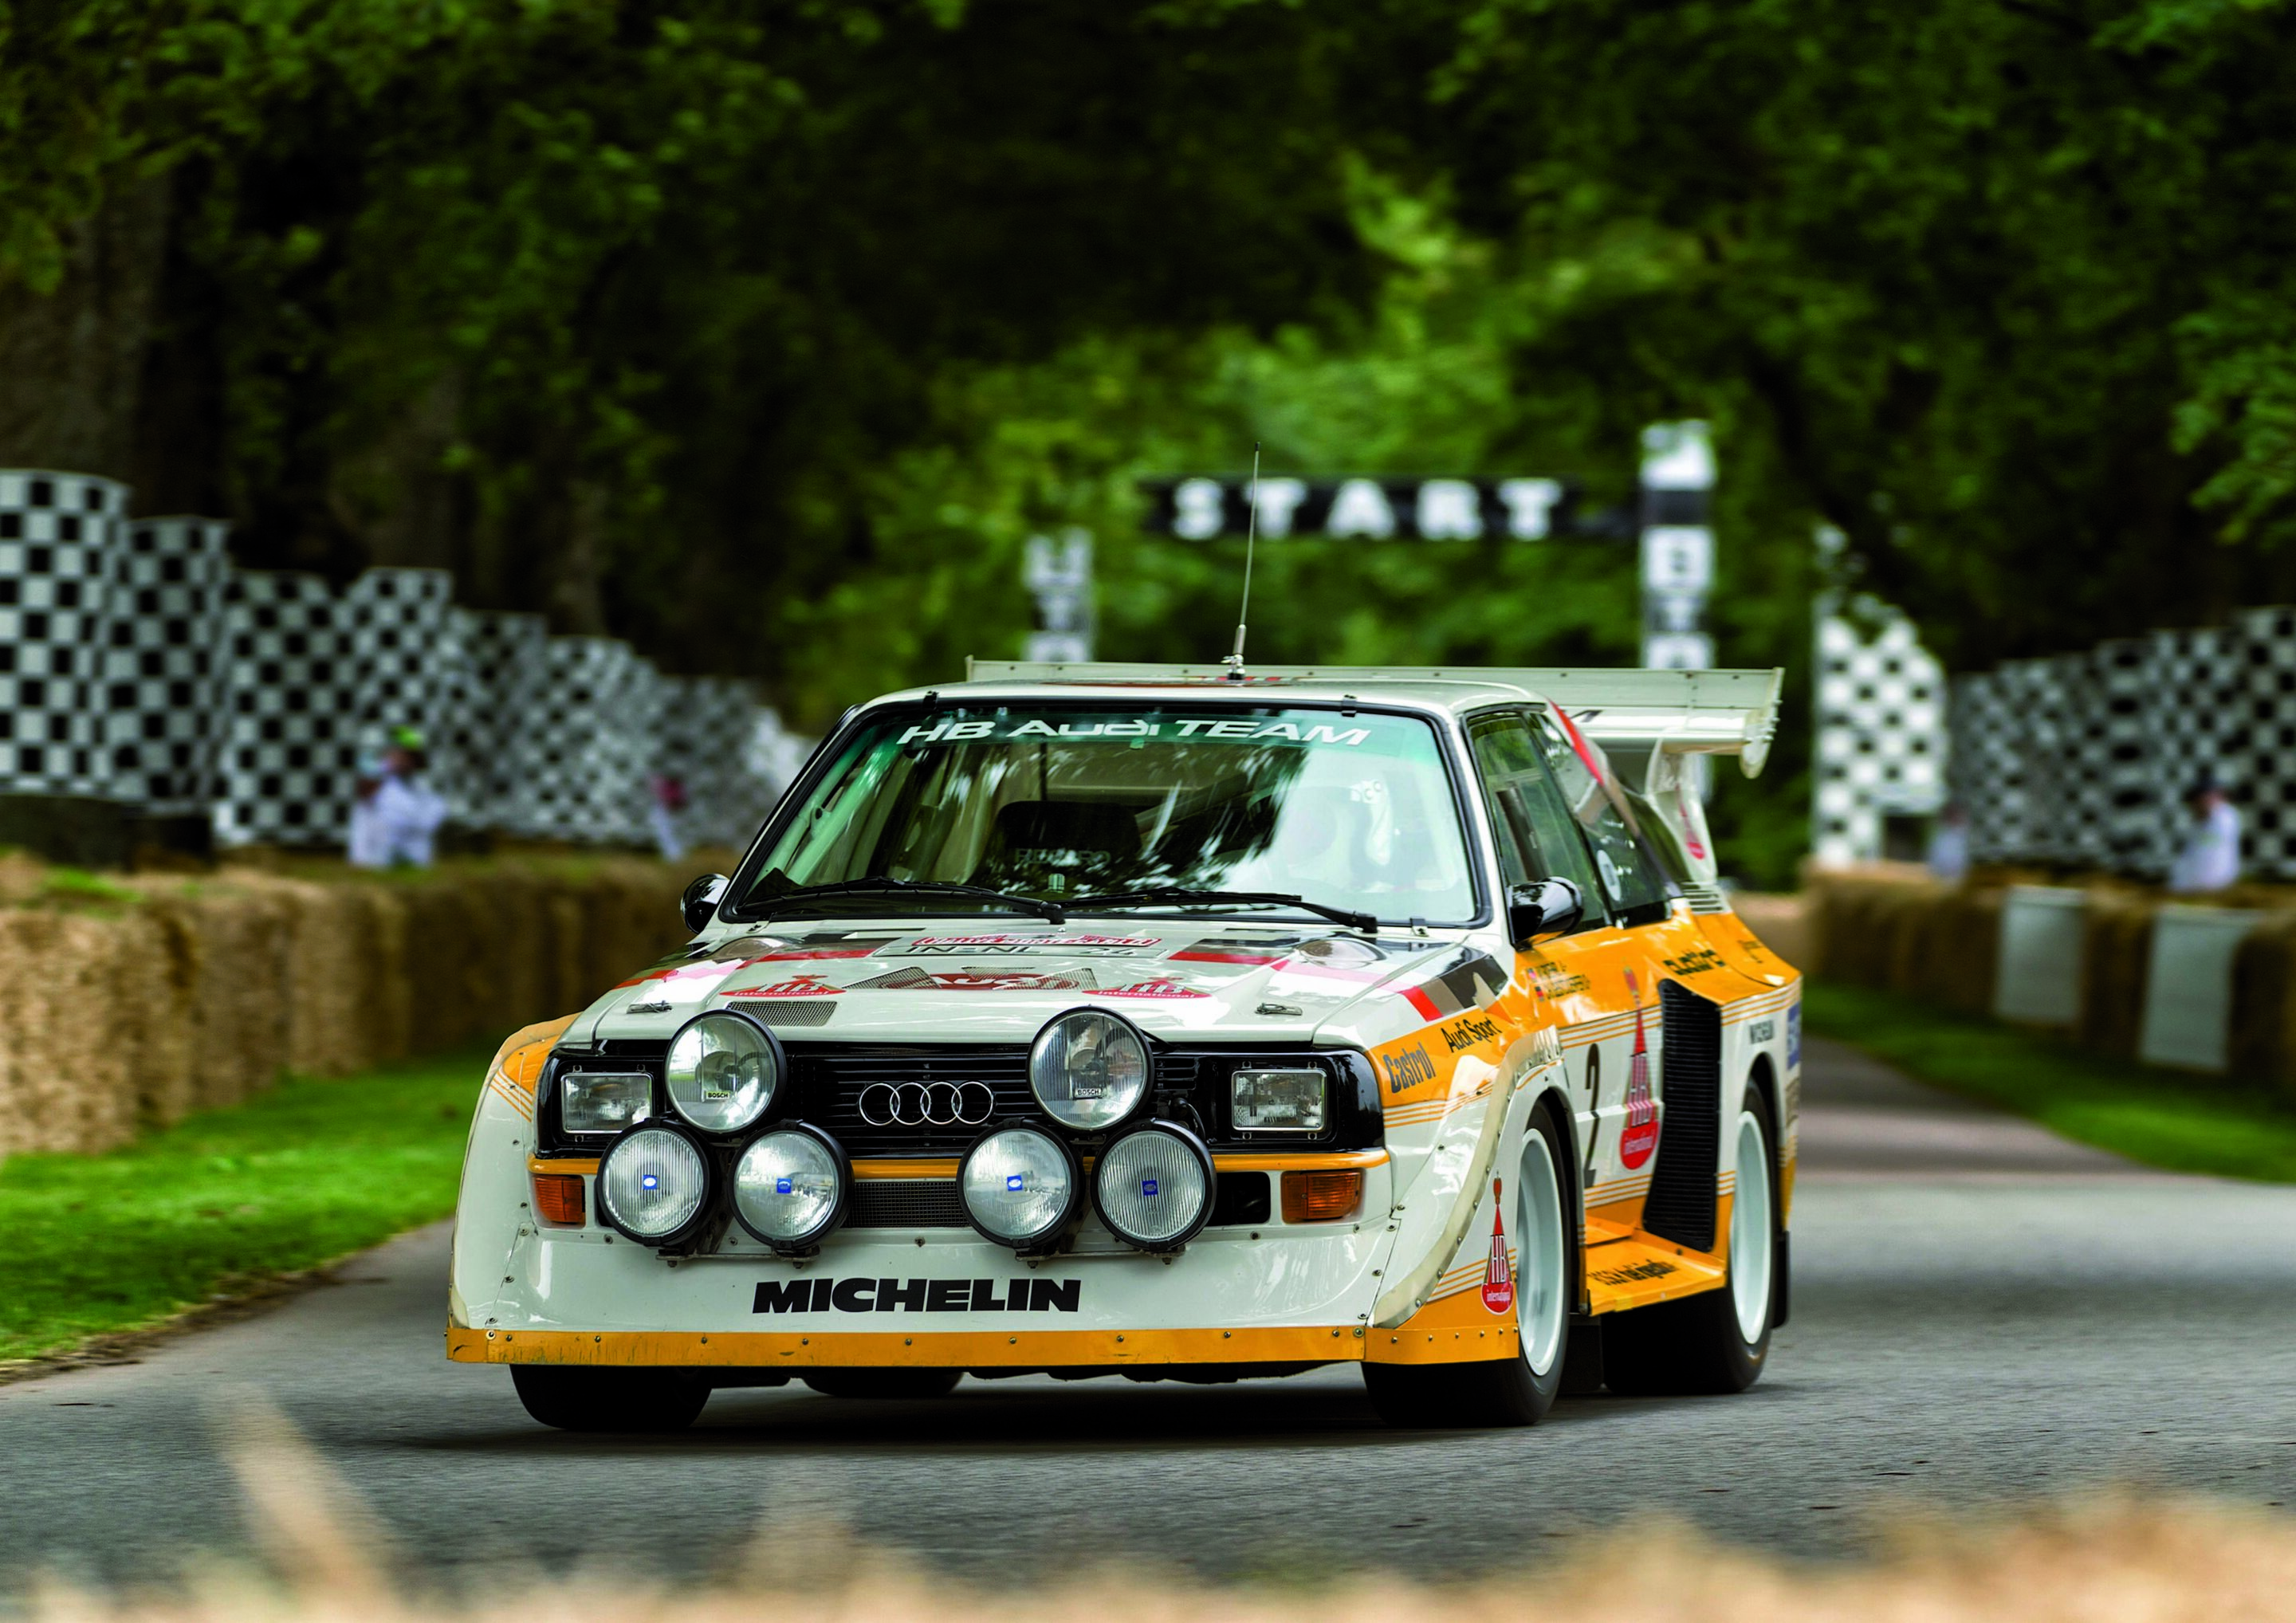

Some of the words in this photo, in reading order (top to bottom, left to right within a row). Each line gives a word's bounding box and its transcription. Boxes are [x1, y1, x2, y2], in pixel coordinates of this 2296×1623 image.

[1172, 477, 1562, 540] START
[896, 720, 997, 745] HB
[1006, 718, 1160, 738] Audi
[1172, 719, 1371, 746] TEAM
[1440, 1021, 1475, 1053] Audi
[1462, 1017, 1503, 1043] Sport
[1382, 1041, 1437, 1094] Castrol
[1580, 1043, 1600, 1188] 2
[752, 1277, 1082, 1314] MICHELIN
